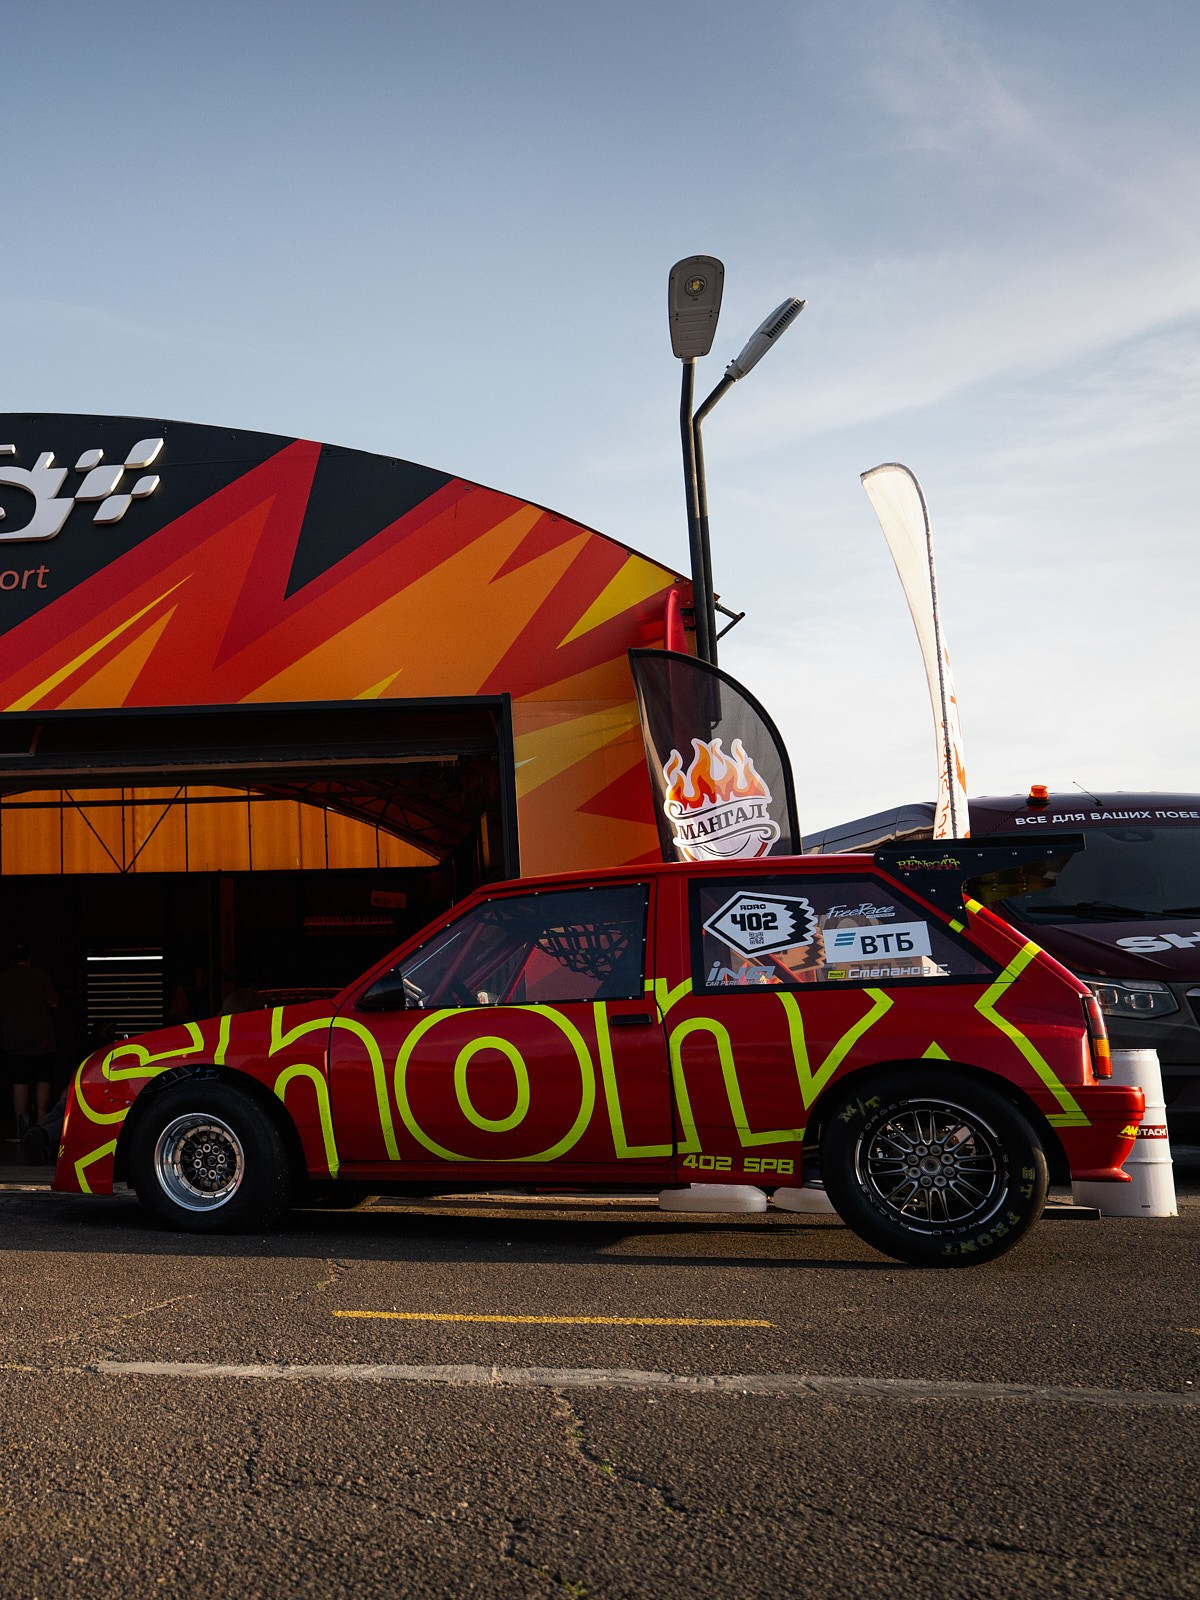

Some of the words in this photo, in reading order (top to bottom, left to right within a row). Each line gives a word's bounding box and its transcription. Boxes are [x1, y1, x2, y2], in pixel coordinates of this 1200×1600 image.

[679, 804, 765, 840] МАНГАЛ
[1015, 816, 1047, 825] ВСЕ
[1052, 813, 1085, 824] ДЛЯ
[1091, 811, 1152, 820] ВАШИХ
[731, 912, 778, 931] 402
[860, 932, 914, 955] ВТБ
[848, 966, 931, 978] Степанов
[838, 1096, 880, 1123] M/T
[860, 1100, 910, 1140] FORGED
[683, 1155, 732, 1171] 402
[743, 1157, 794, 1175] SPB
